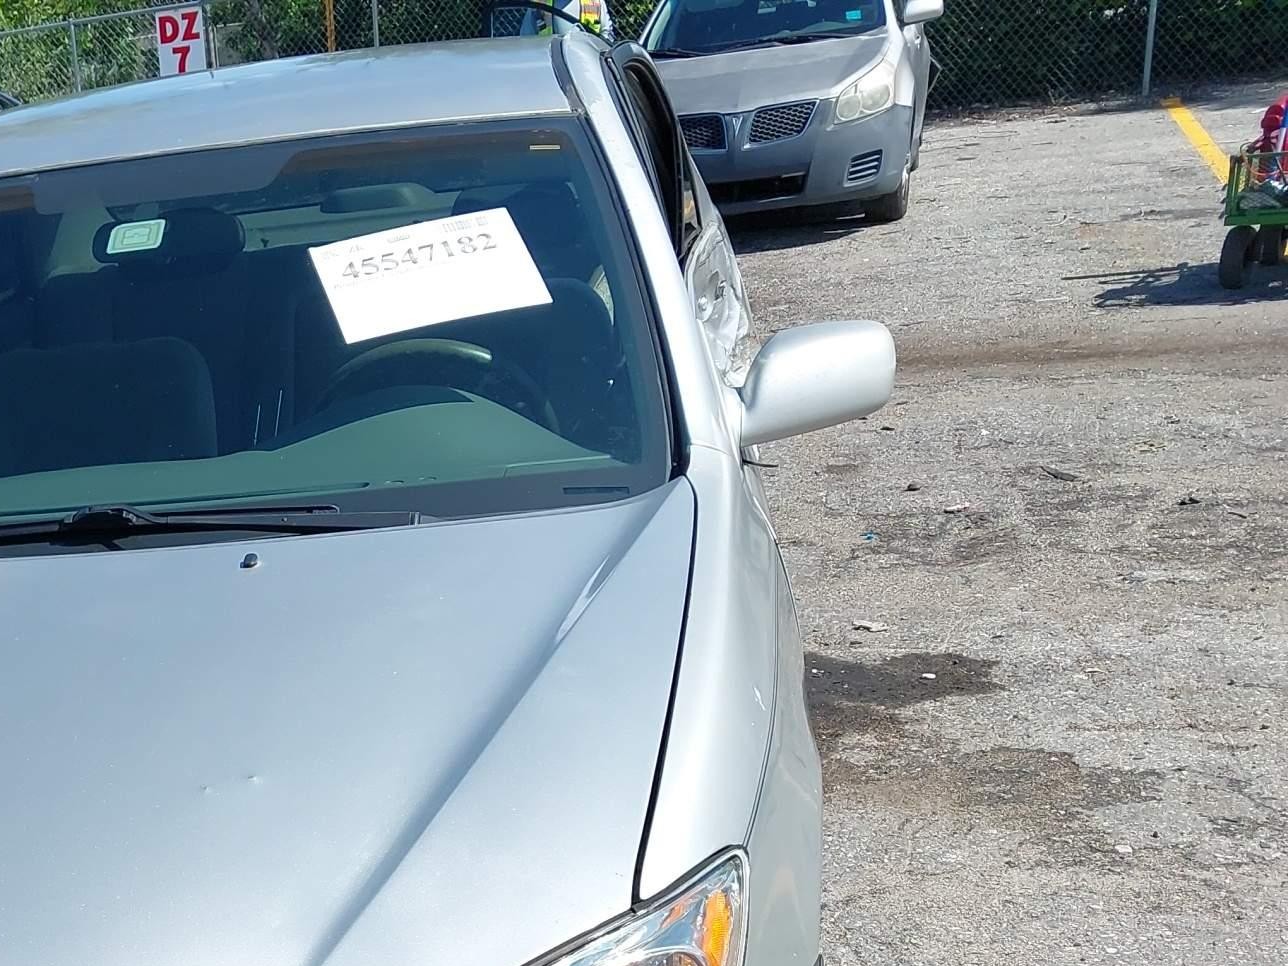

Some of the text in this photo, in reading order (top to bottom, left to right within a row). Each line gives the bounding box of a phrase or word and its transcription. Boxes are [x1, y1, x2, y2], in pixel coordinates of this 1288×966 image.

[158, 10, 201, 45] DZ
[172, 45, 191, 74] 7
[341, 232, 498, 279] 45547182
